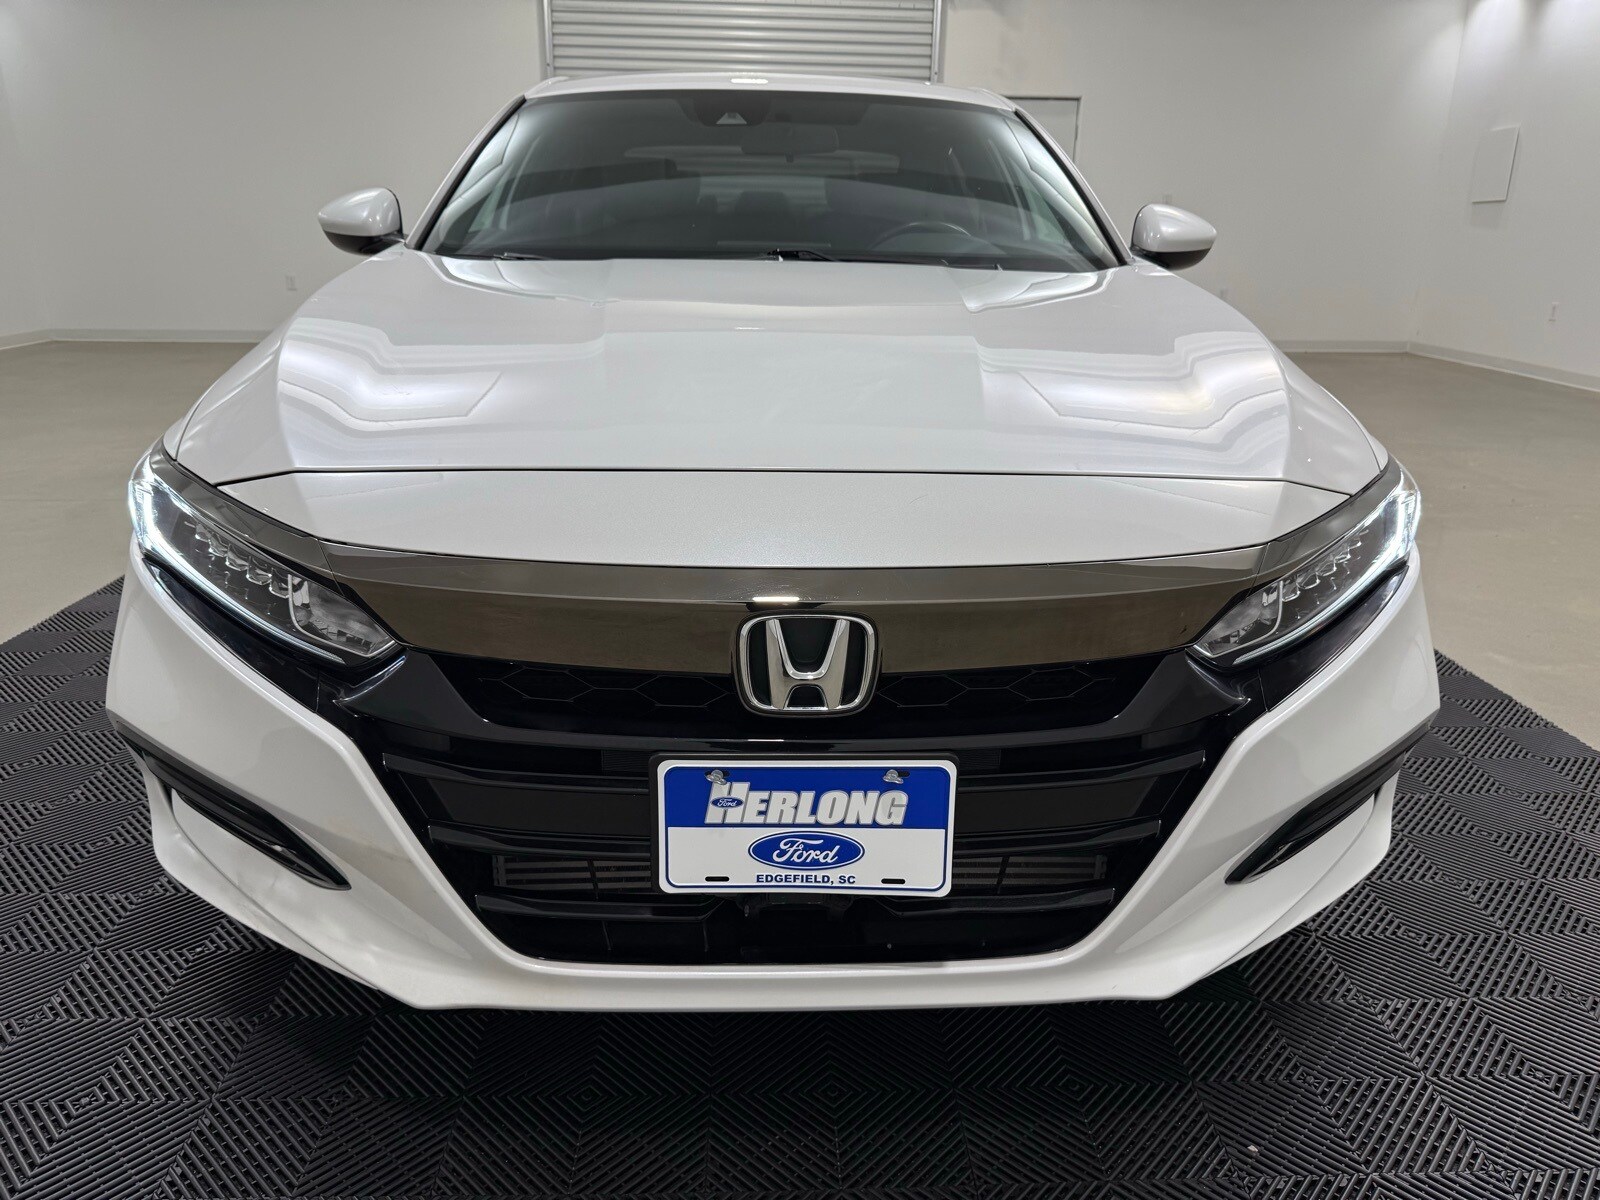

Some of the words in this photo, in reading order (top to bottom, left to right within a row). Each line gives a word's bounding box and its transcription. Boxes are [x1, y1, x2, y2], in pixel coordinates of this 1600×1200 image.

[766, 619, 850, 710] H
[704, 781, 908, 825] HERLONG
[717, 798, 737, 808] Ford
[772, 838, 840, 863] Ford
[756, 874, 834, 885] EDGEFIELD,
[838, 875, 856, 884] SC
